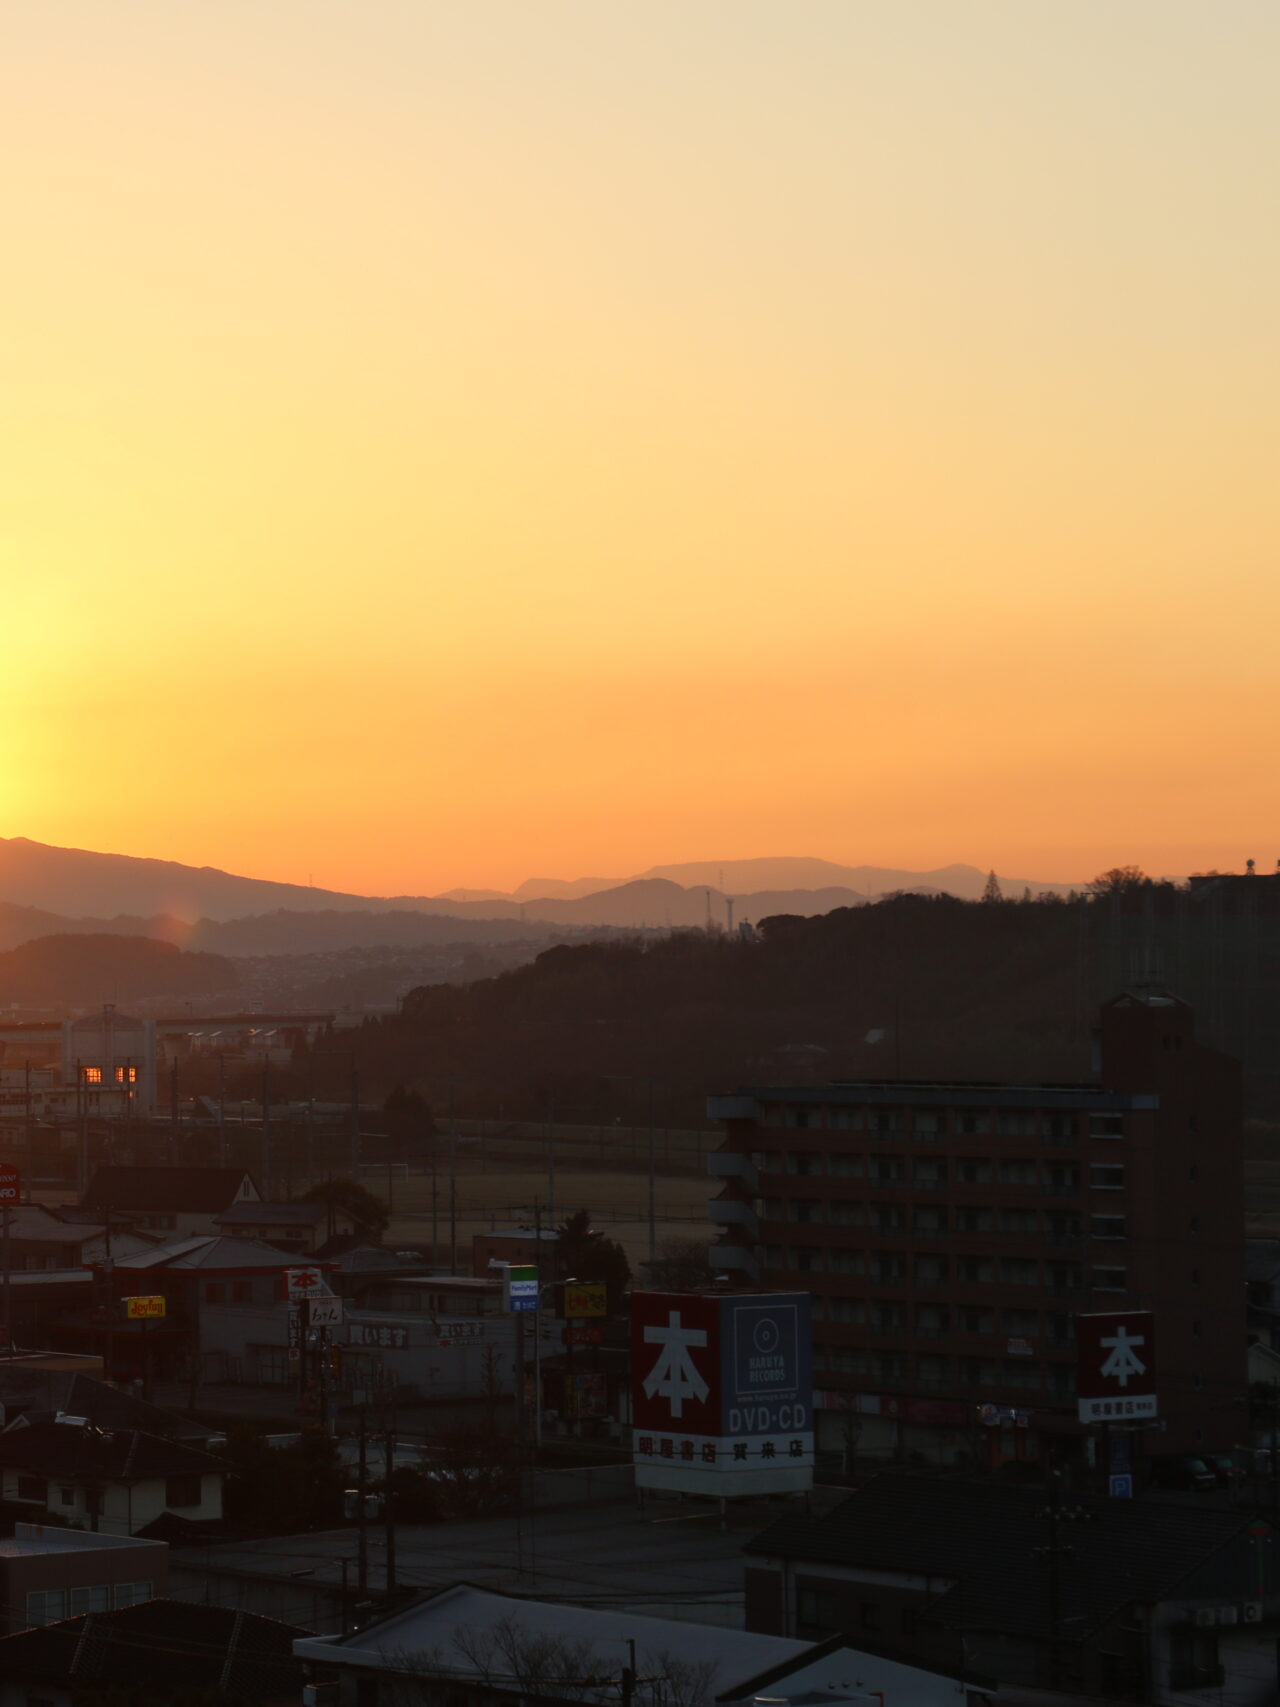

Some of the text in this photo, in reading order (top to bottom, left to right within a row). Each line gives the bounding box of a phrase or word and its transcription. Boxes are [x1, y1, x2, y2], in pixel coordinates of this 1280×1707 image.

[131, 1299, 163, 1316] Joyfull
[641, 1310, 711, 1419] 本
[749, 1354, 786, 1370] HARUYA
[1099, 1325, 1149, 1388] 本
[749, 1368, 787, 1384] RECORDS
[638, 1436, 717, 1464] 明屋書店
[1115, 1480, 1127, 1497] P
